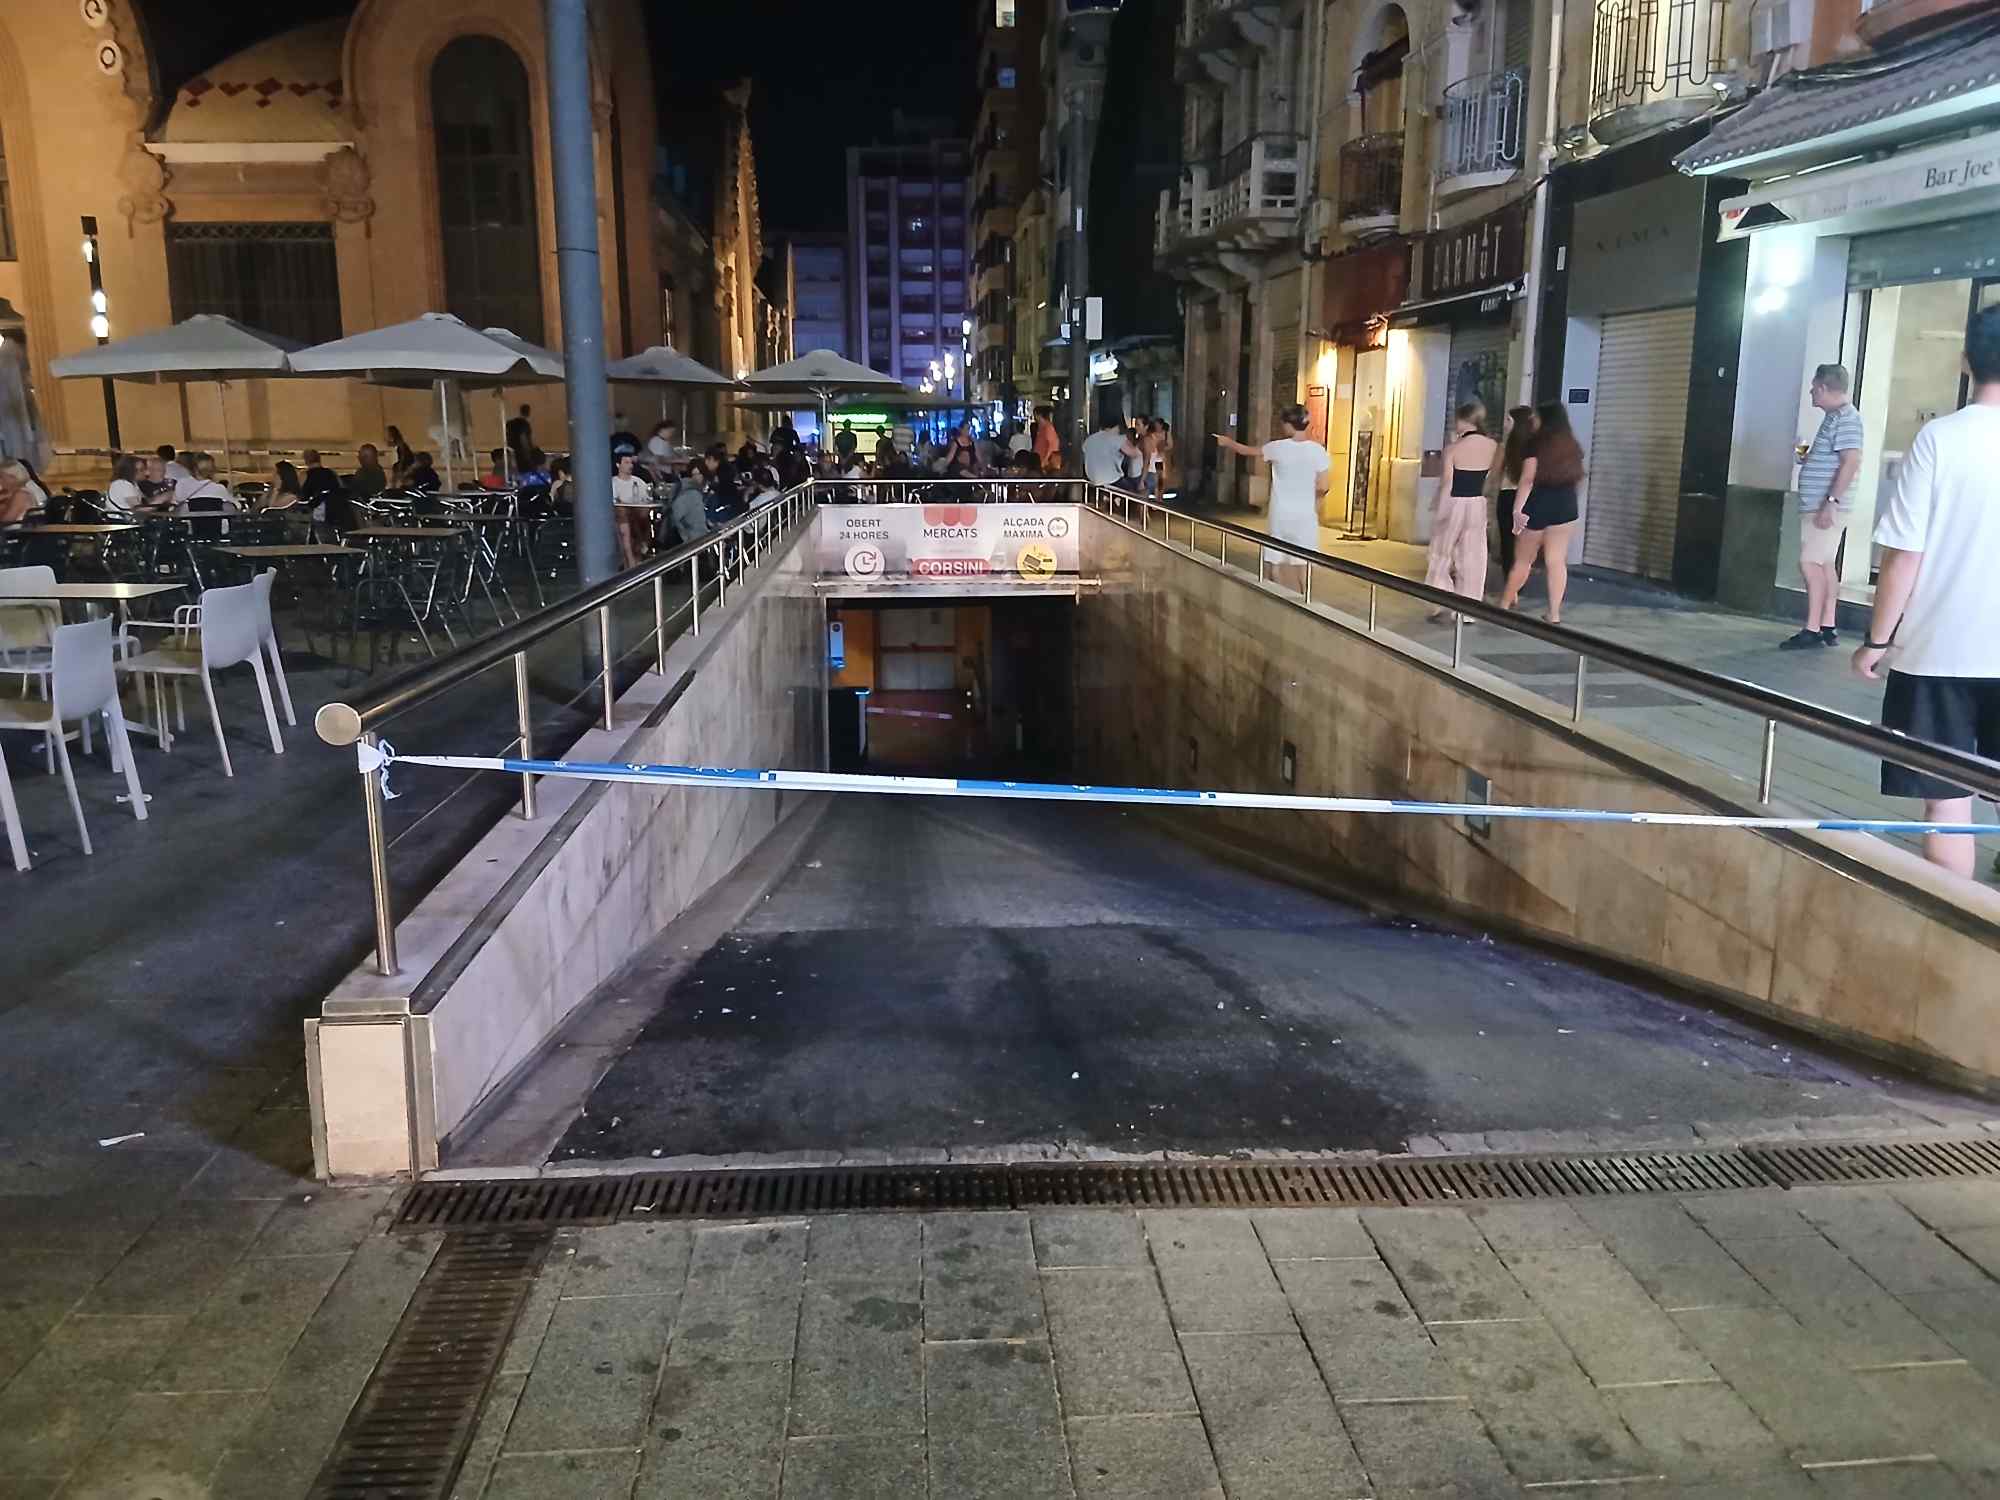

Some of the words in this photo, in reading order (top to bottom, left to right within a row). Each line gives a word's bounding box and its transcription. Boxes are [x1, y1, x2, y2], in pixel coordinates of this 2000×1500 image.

[1924, 167, 1958, 189] Bar
[1957, 160, 1993, 187] Joe
[847, 519, 880, 528] OBERT
[1003, 518, 1045, 528] ALÇADA
[839, 531, 850, 540] 24
[853, 531, 889, 540] HORES
[923, 528, 978, 538] MERCATS
[919, 561, 983, 575] CORSINI
